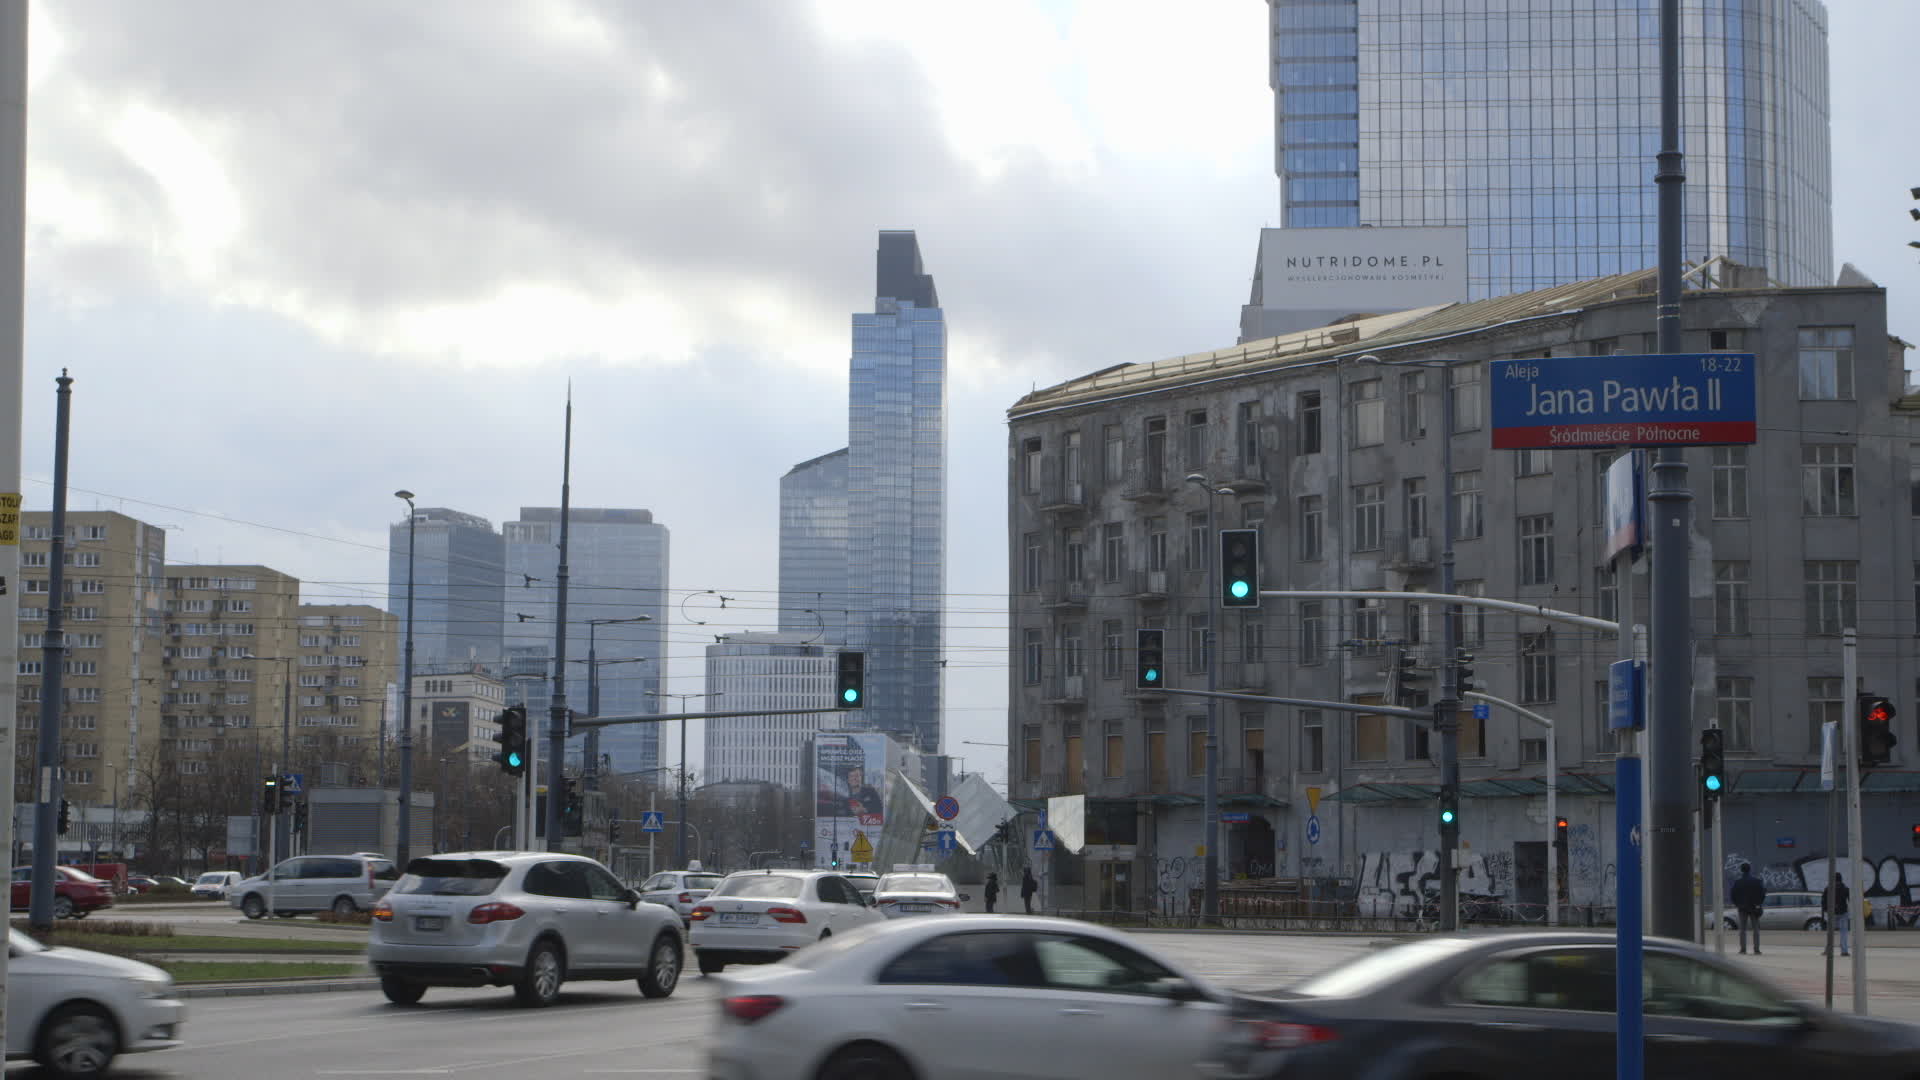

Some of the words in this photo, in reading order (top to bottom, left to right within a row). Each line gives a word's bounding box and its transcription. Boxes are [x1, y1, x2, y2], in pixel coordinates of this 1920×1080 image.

[1286, 256, 1444, 268] NUTRIDOME.PL
[1505, 364, 1539, 381] Aleja
[1700, 358, 1742, 372] 18-22
[1526, 383, 1594, 416] Jana
[1603, 376, 1699, 413] Pawła
[1708, 378, 1721, 411] II
[1550, 426, 1631, 443] Śródmieście
[1637, 425, 1701, 441] Północne
